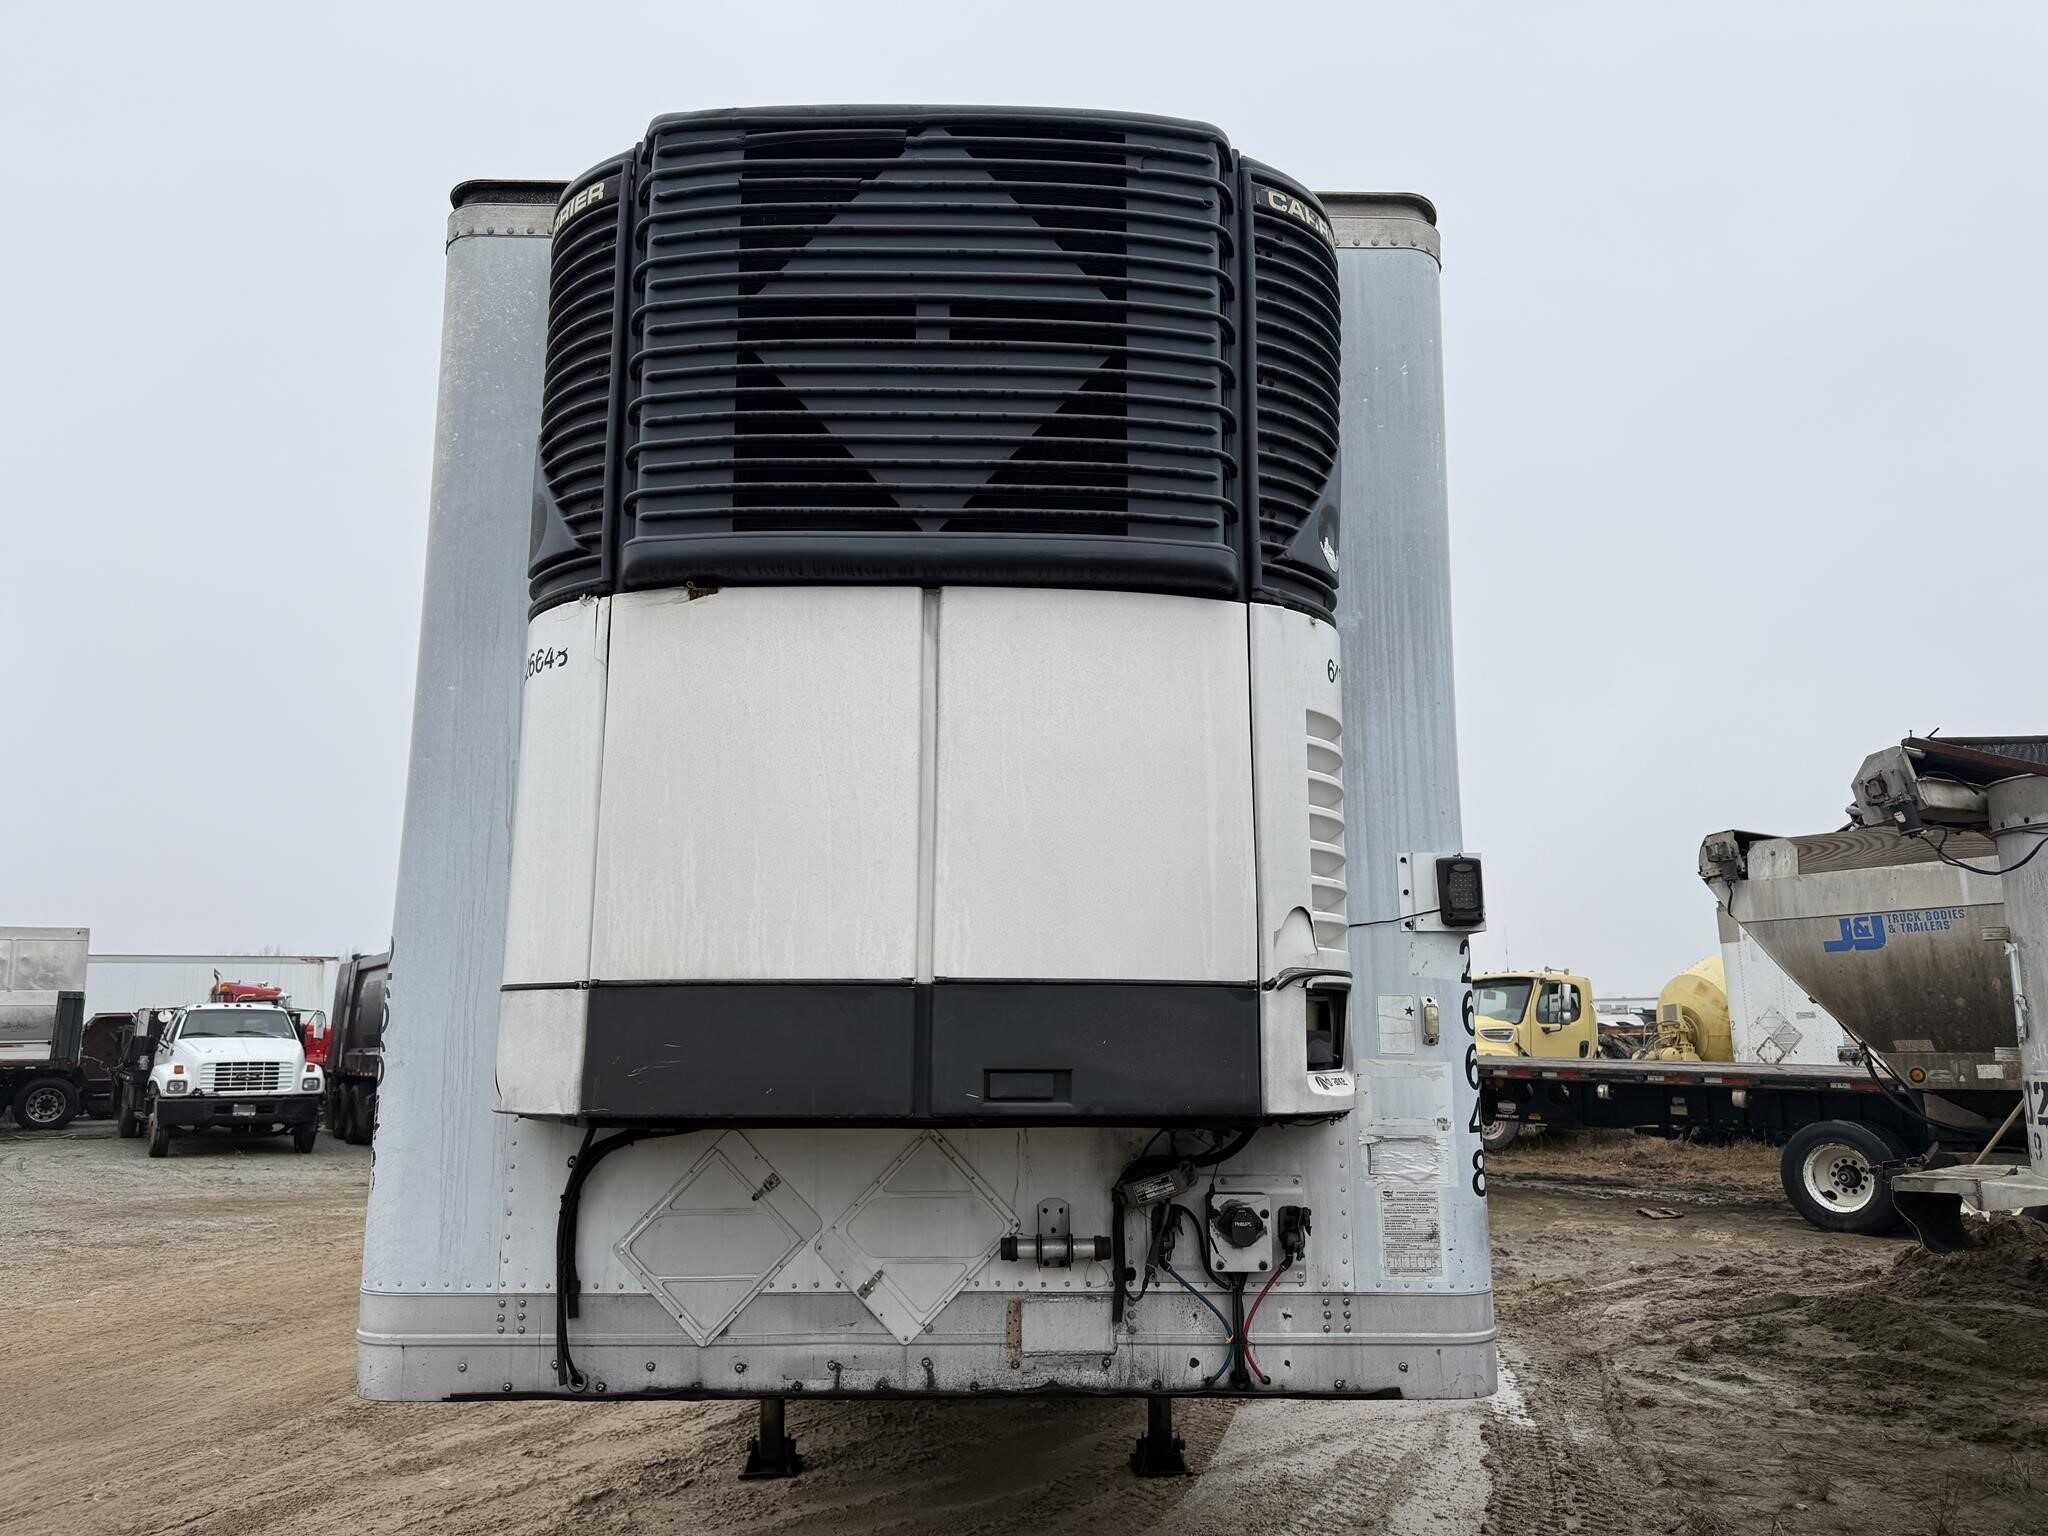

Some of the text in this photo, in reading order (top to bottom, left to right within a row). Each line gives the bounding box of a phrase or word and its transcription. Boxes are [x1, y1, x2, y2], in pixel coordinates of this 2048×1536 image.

[1886, 908, 1966, 925] TRUCK BODIES
[1823, 914, 1888, 953] J&J
[1888, 920, 1951, 934] & TRAILERS
